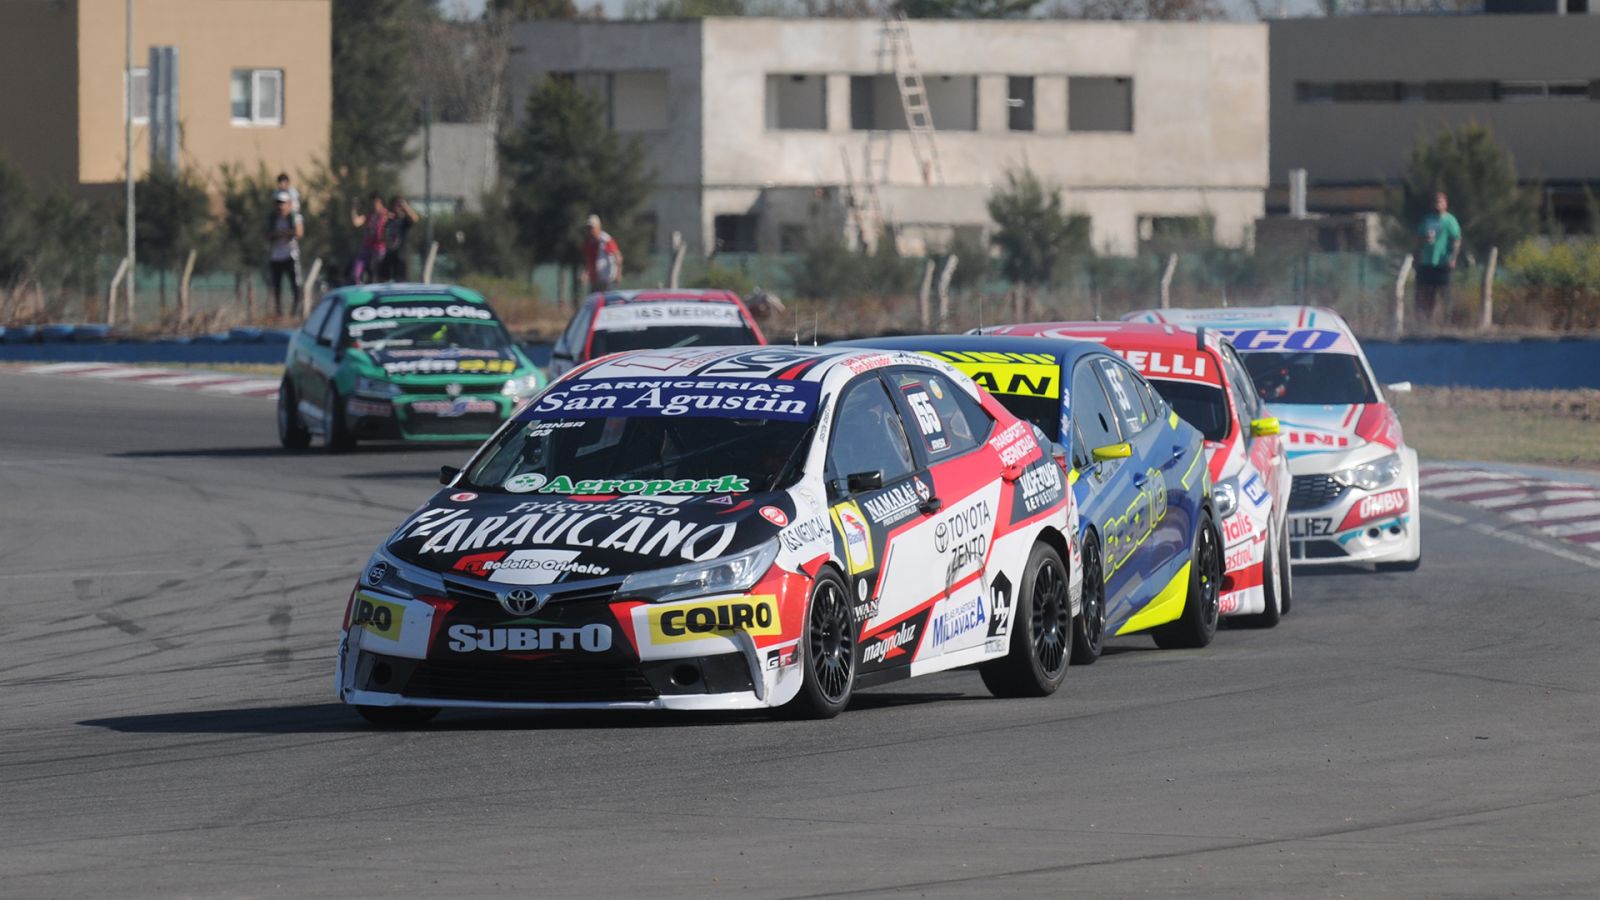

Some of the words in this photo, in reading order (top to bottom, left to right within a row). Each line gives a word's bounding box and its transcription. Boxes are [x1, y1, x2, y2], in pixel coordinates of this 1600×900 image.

[534, 392, 617, 412] San
[622, 387, 806, 416] Agustin
[907, 391, 941, 435] 155
[538, 474, 750, 496] Agropark
[864, 485, 915, 521] NAMARA
[418, 513, 737, 562] ARAUCANO
[782, 530, 803, 553] I&S
[795, 516, 830, 541] MEDICAL
[949, 500, 991, 542] TOYOTA
[482, 559, 540, 571] Rodolfo
[542, 560, 610, 575] Cristales
[951, 534, 986, 572] ZENTO
[1225, 545, 1254, 571] astrol
[661, 602, 772, 636] COIRO
[448, 623, 612, 653] SUBITO
[863, 622, 916, 663] magnoluz
